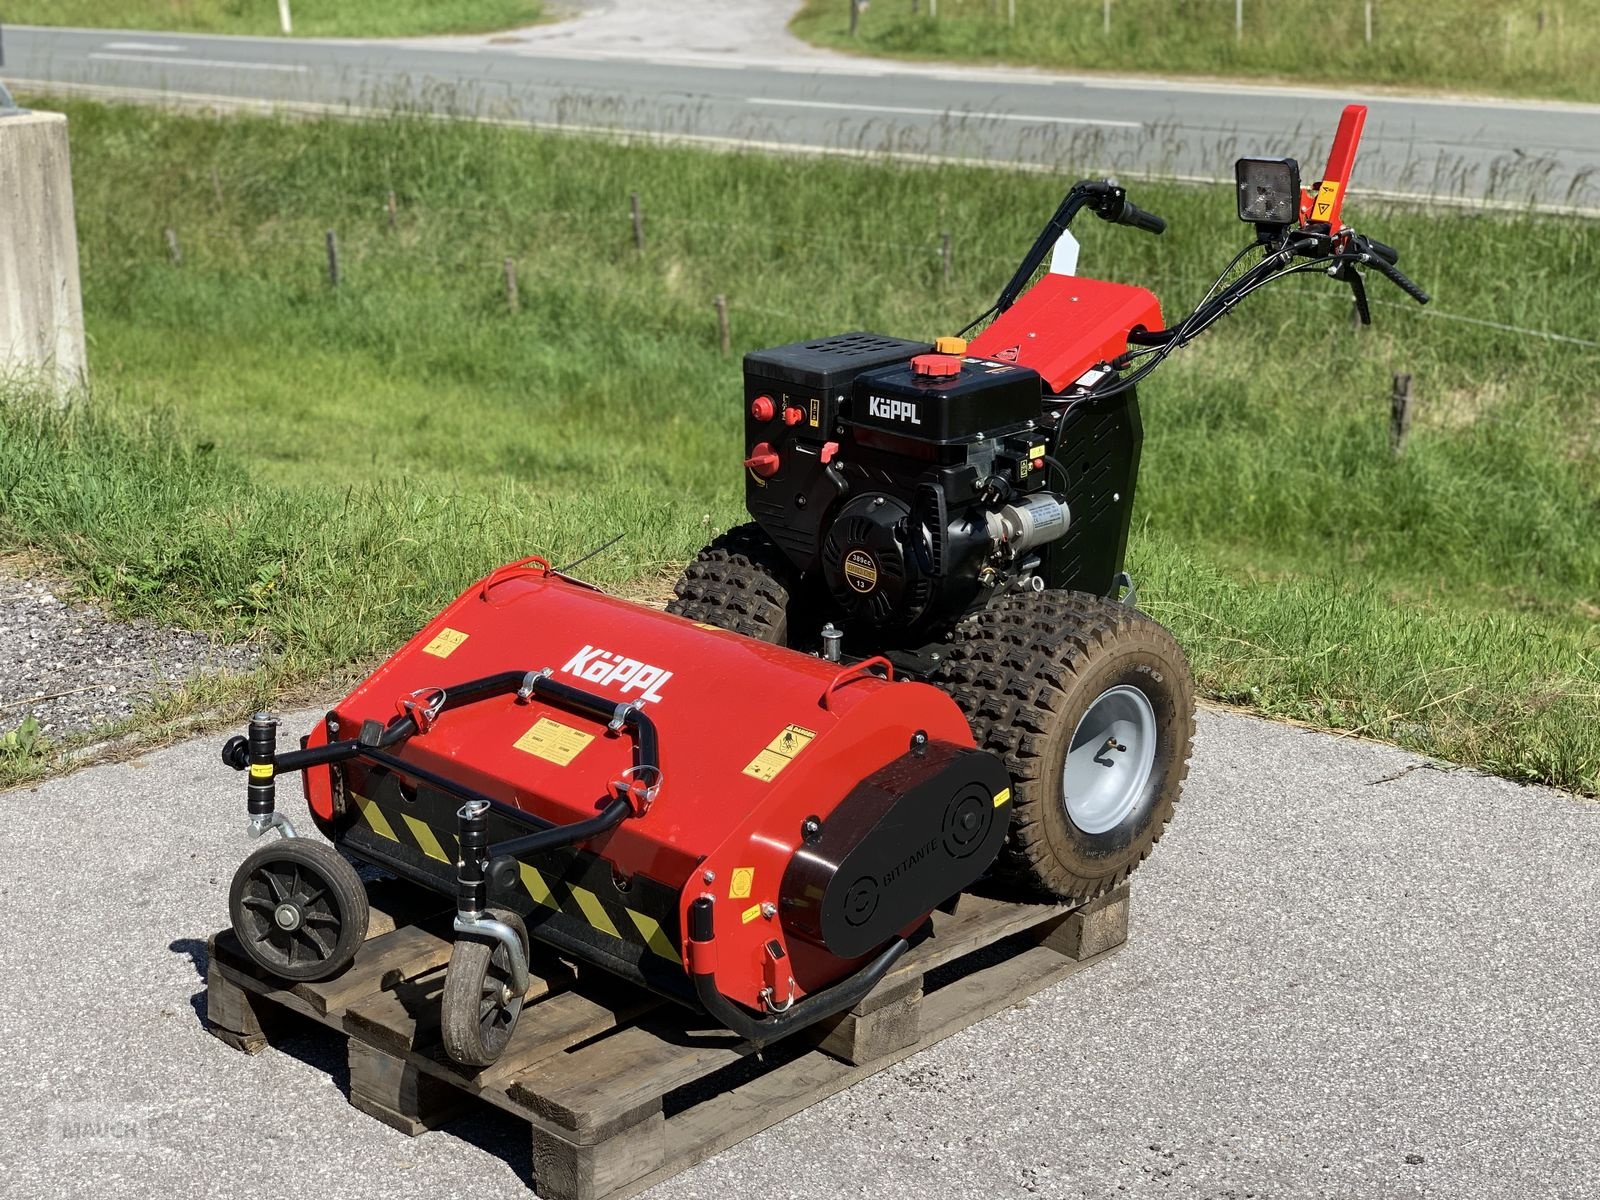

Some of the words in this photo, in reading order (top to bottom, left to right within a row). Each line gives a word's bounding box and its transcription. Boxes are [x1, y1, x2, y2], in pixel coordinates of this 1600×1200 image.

[852, 554, 871, 566] 389cc
[856, 580, 865, 588] 13
[882, 837, 938, 887] BITTANTE
